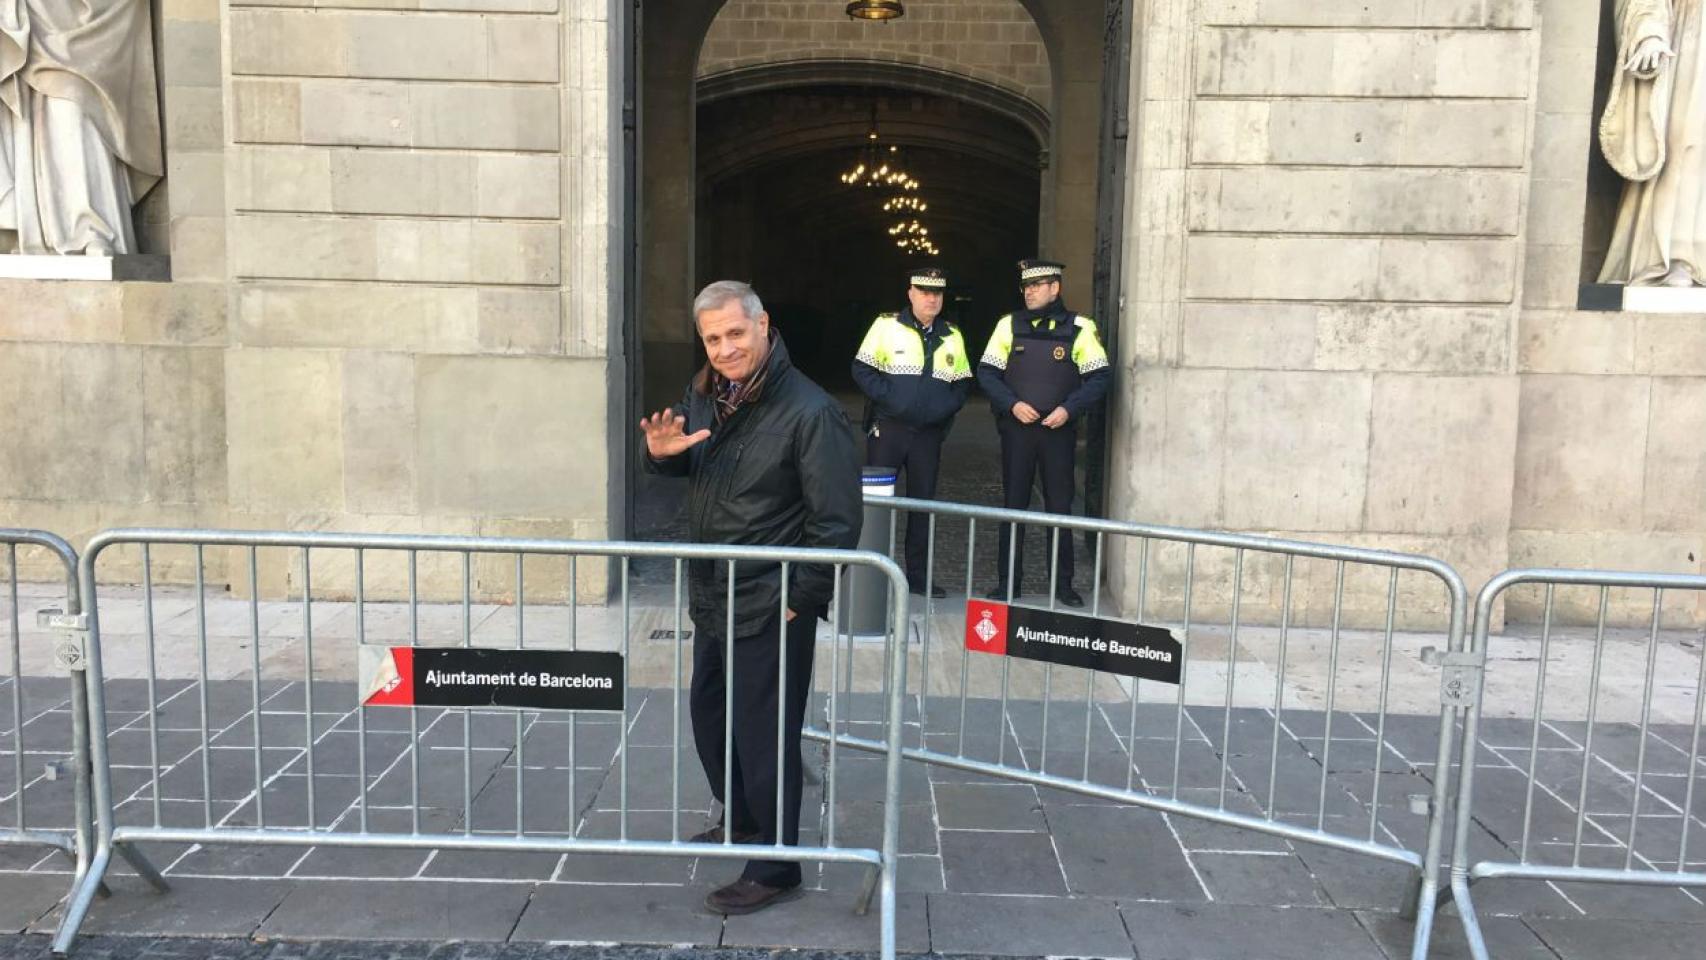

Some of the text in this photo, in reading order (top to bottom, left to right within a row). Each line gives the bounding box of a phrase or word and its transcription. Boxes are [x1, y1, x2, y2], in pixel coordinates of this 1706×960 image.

[1016, 626, 1172, 663] Ajuntament de Barcelona
[425, 669, 612, 689] Ajuntament de Barcelona
